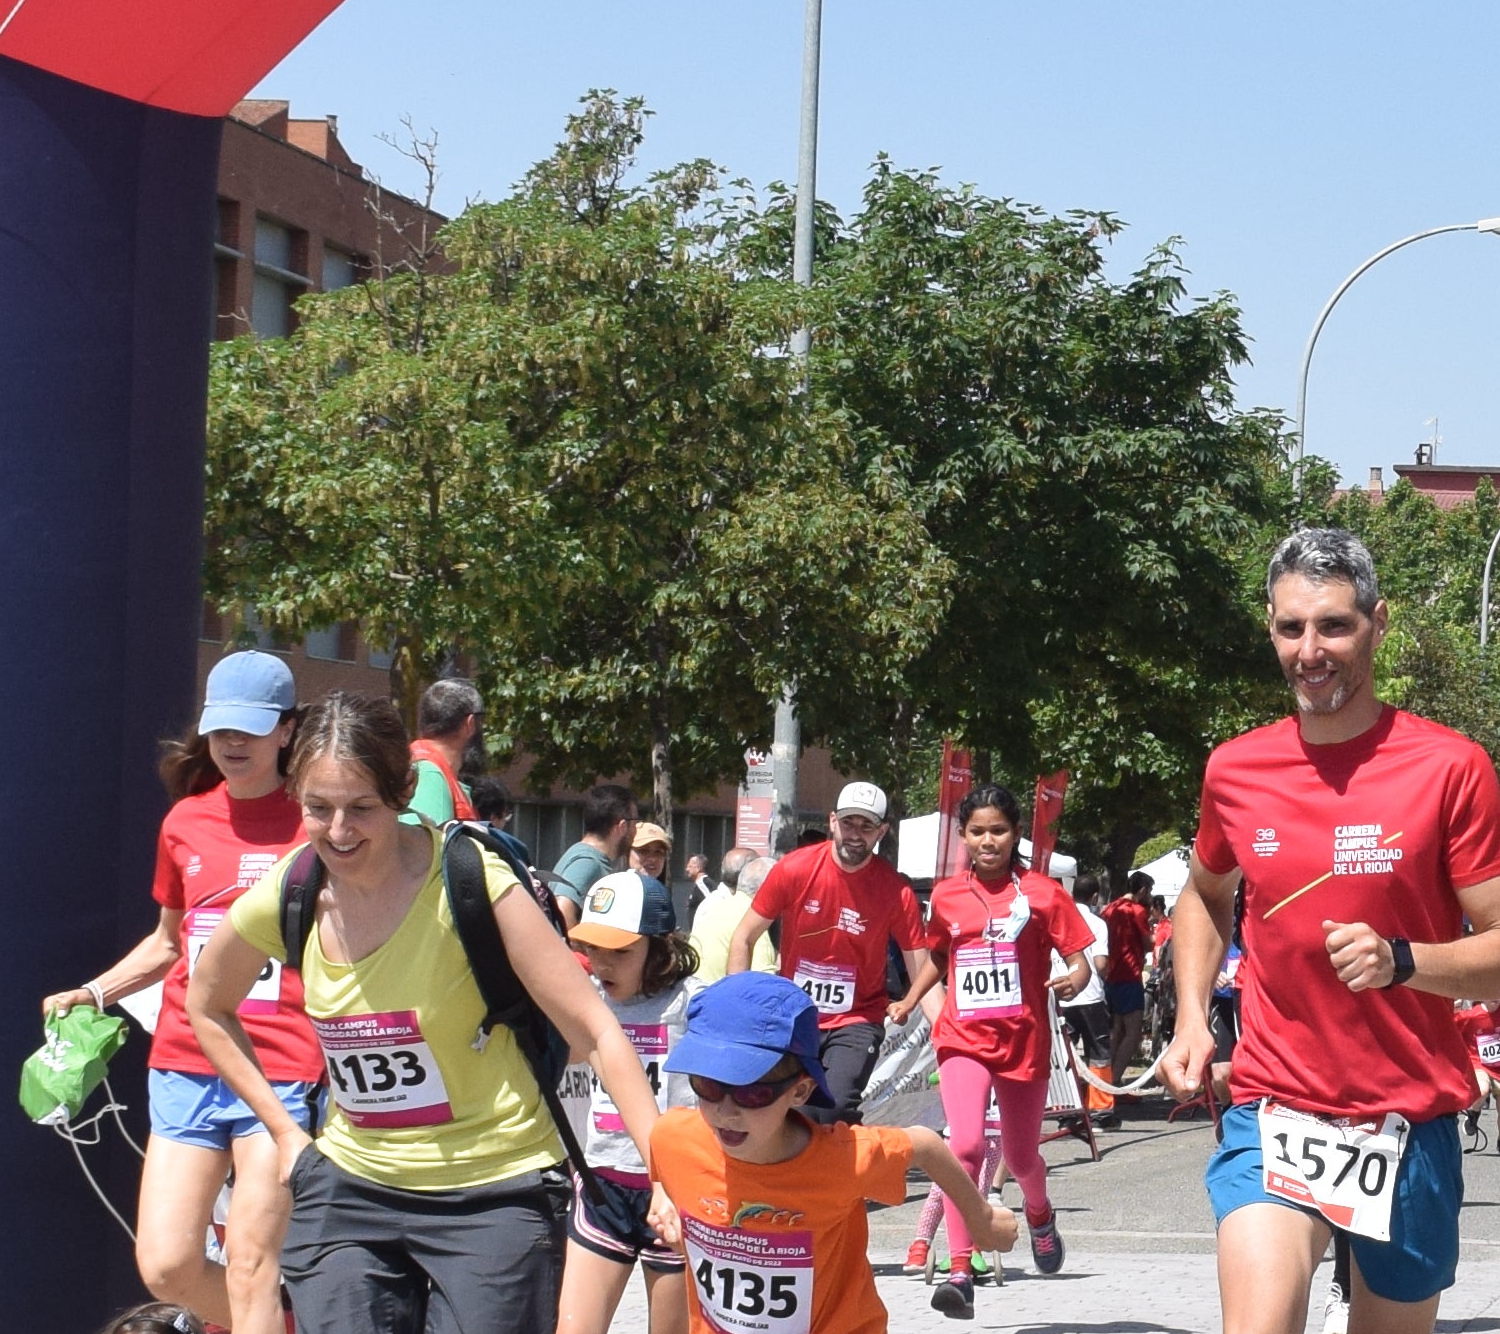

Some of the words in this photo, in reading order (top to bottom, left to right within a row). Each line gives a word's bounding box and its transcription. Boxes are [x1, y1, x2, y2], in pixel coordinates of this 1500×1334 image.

[1334, 824, 1382, 837] CARRERA
[1333, 848, 1403, 862] UNIVERSIDAD
[1334, 837, 1378, 850] CAMPUS
[1333, 863, 1348, 875] DE
[1349, 862, 1363, 874] LA
[1364, 861, 1393, 874] RIOJA
[802, 980, 845, 1004] 4115
[963, 968, 1011, 995] 4011
[338, 1019, 378, 1030] CAMPUS
[386, 1026, 413, 1036] RIOJA
[327, 1050, 427, 1094] 4133
[1273, 1132, 1388, 1197] 1570
[684, 1217, 724, 1238] CARRERA
[726, 1233, 769, 1246] CAMPUS
[686, 1224, 745, 1249] UNIVERSIDAD
[746, 1245, 760, 1253] DE
[776, 1247, 806, 1256] RIOJA
[696, 1259, 798, 1318] 4135
